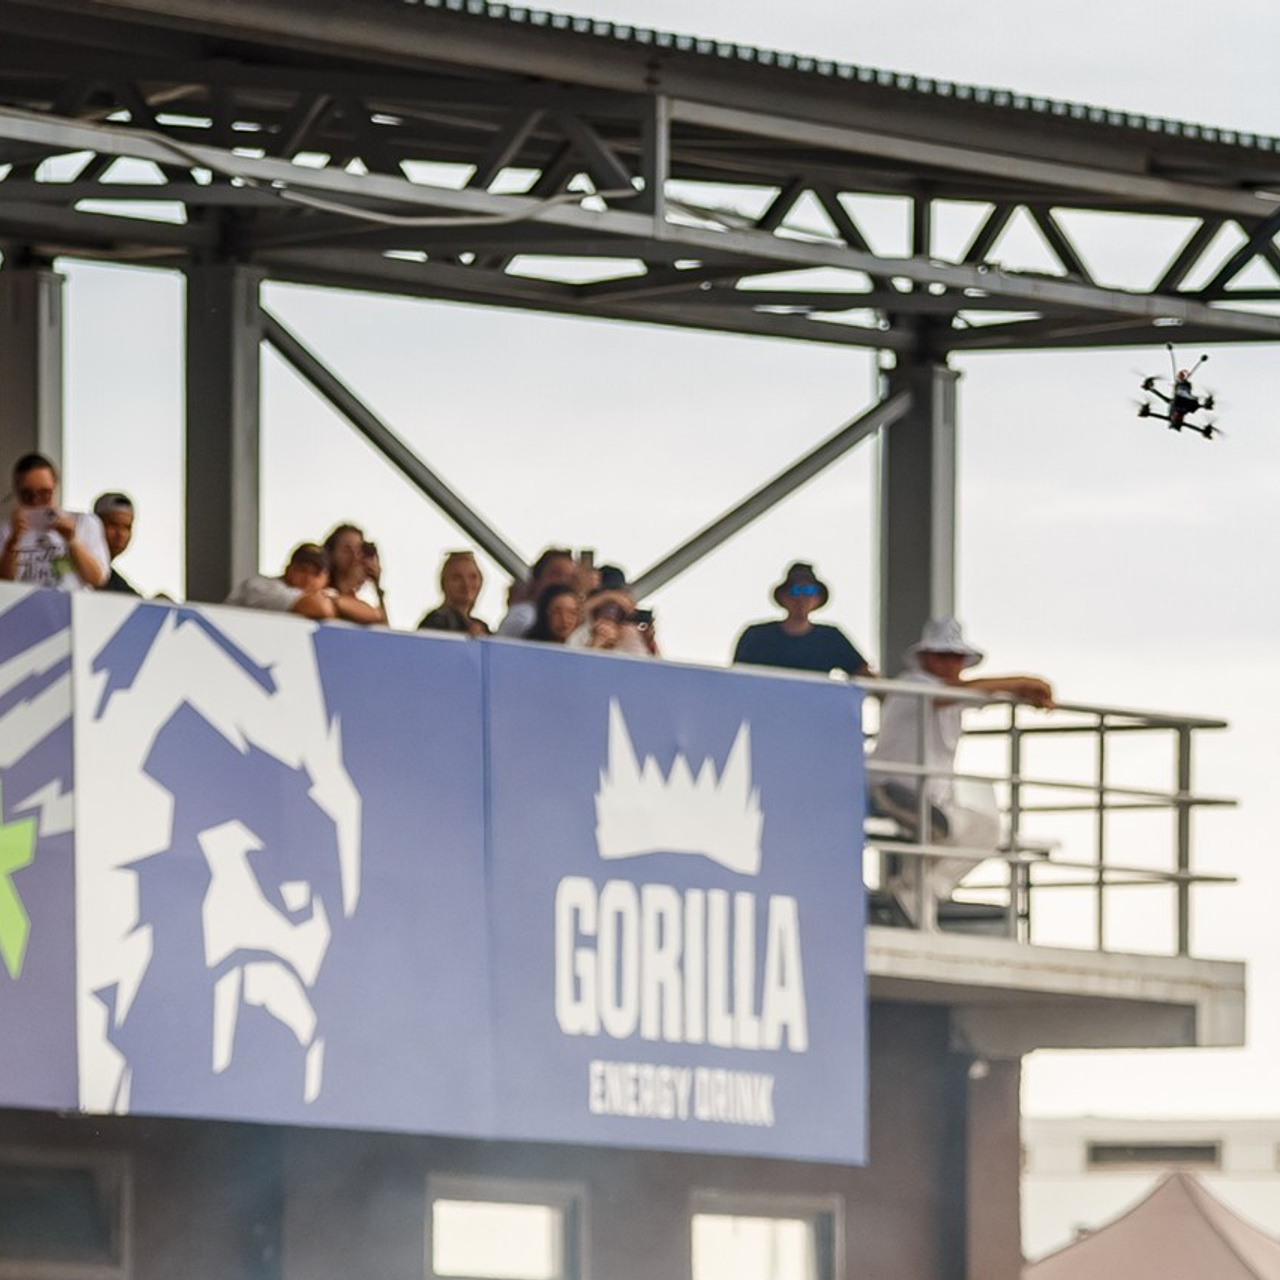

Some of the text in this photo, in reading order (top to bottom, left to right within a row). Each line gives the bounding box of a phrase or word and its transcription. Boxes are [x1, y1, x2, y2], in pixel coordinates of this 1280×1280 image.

[555, 875, 808, 1052] GORILLA
[589, 1060, 775, 1127] ENERGY DRINK
